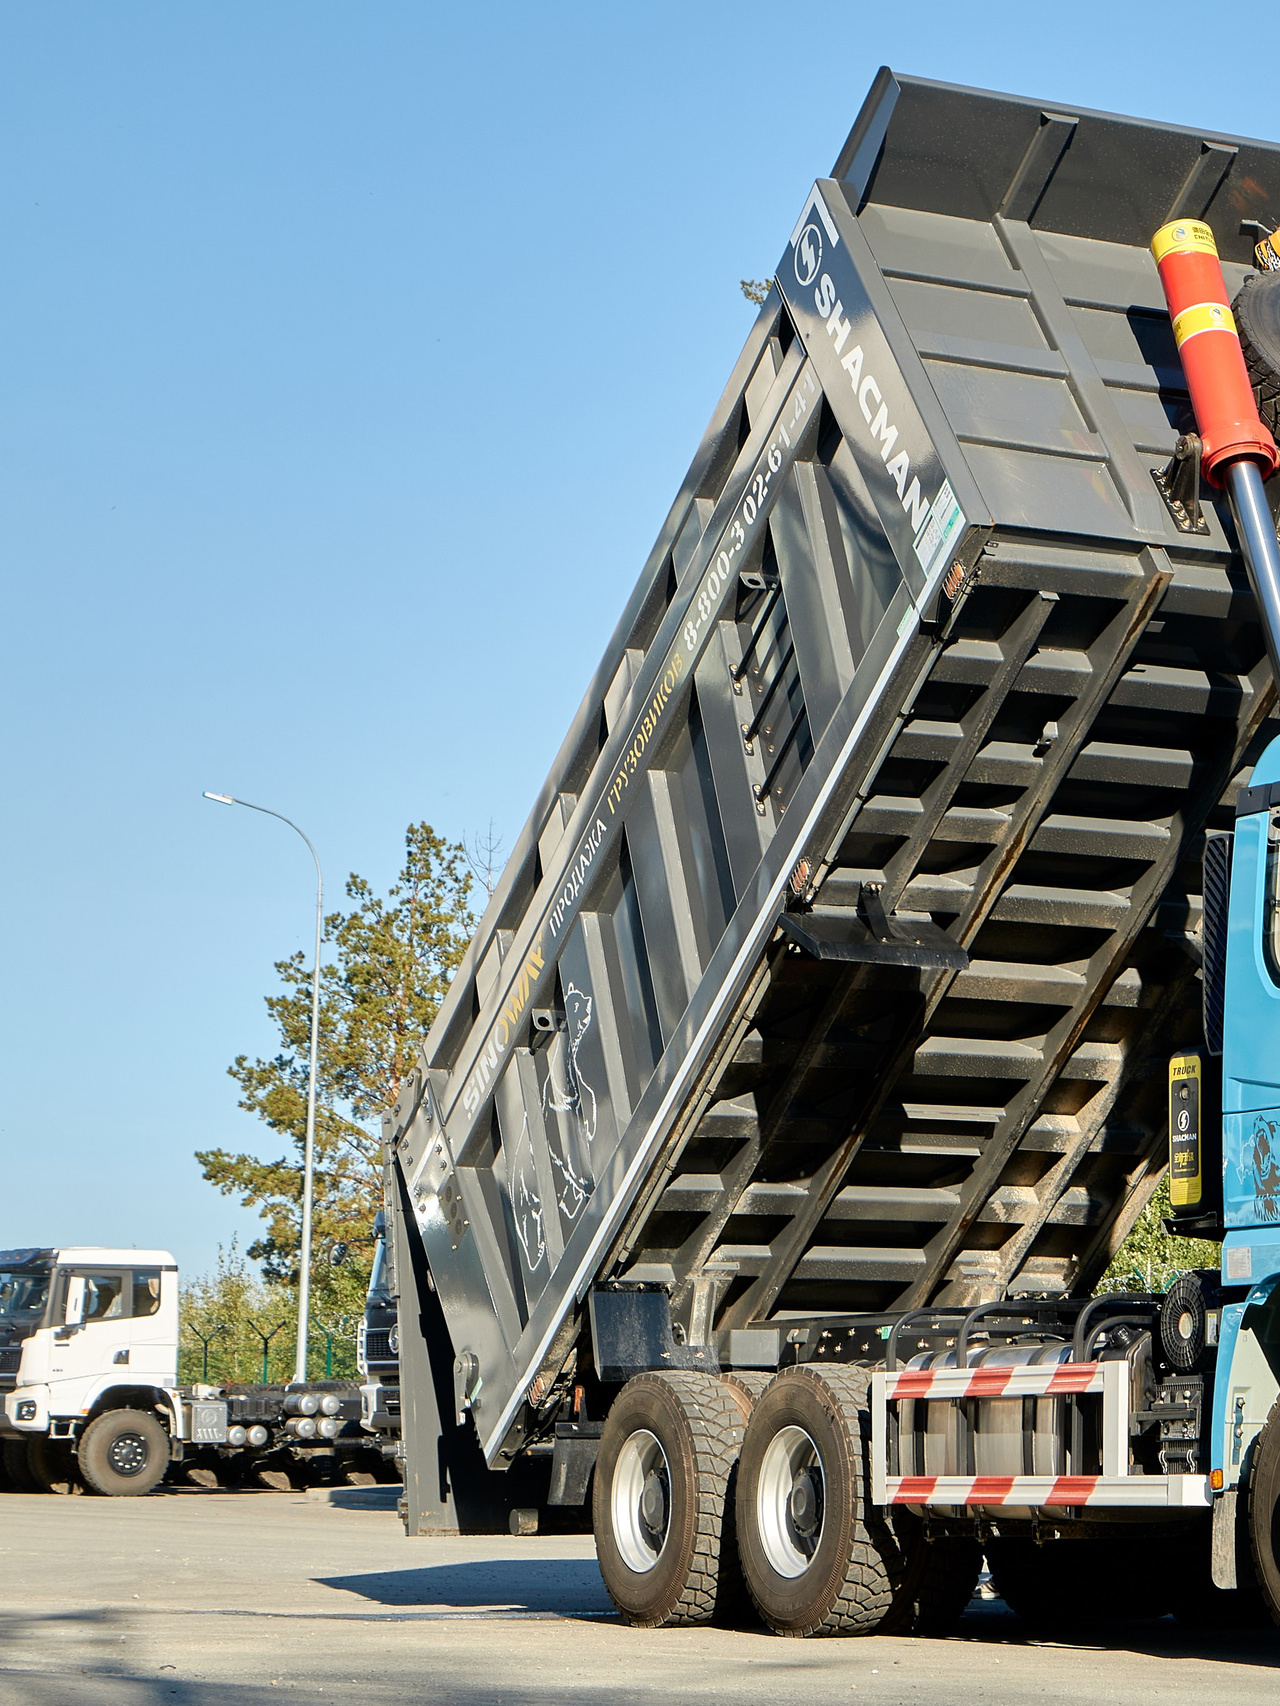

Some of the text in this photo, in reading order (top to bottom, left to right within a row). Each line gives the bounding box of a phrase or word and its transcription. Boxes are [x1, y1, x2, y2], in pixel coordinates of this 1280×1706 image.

[814, 273, 931, 535] SHACMAN
[549, 818, 608, 938] ПРОДАЖА
[606, 652, 684, 815] ГРУЗОВИКОВ
[1172, 1132, 1197, 1143] SHACMAN
[1173, 1065, 1197, 1076] TRUCK
